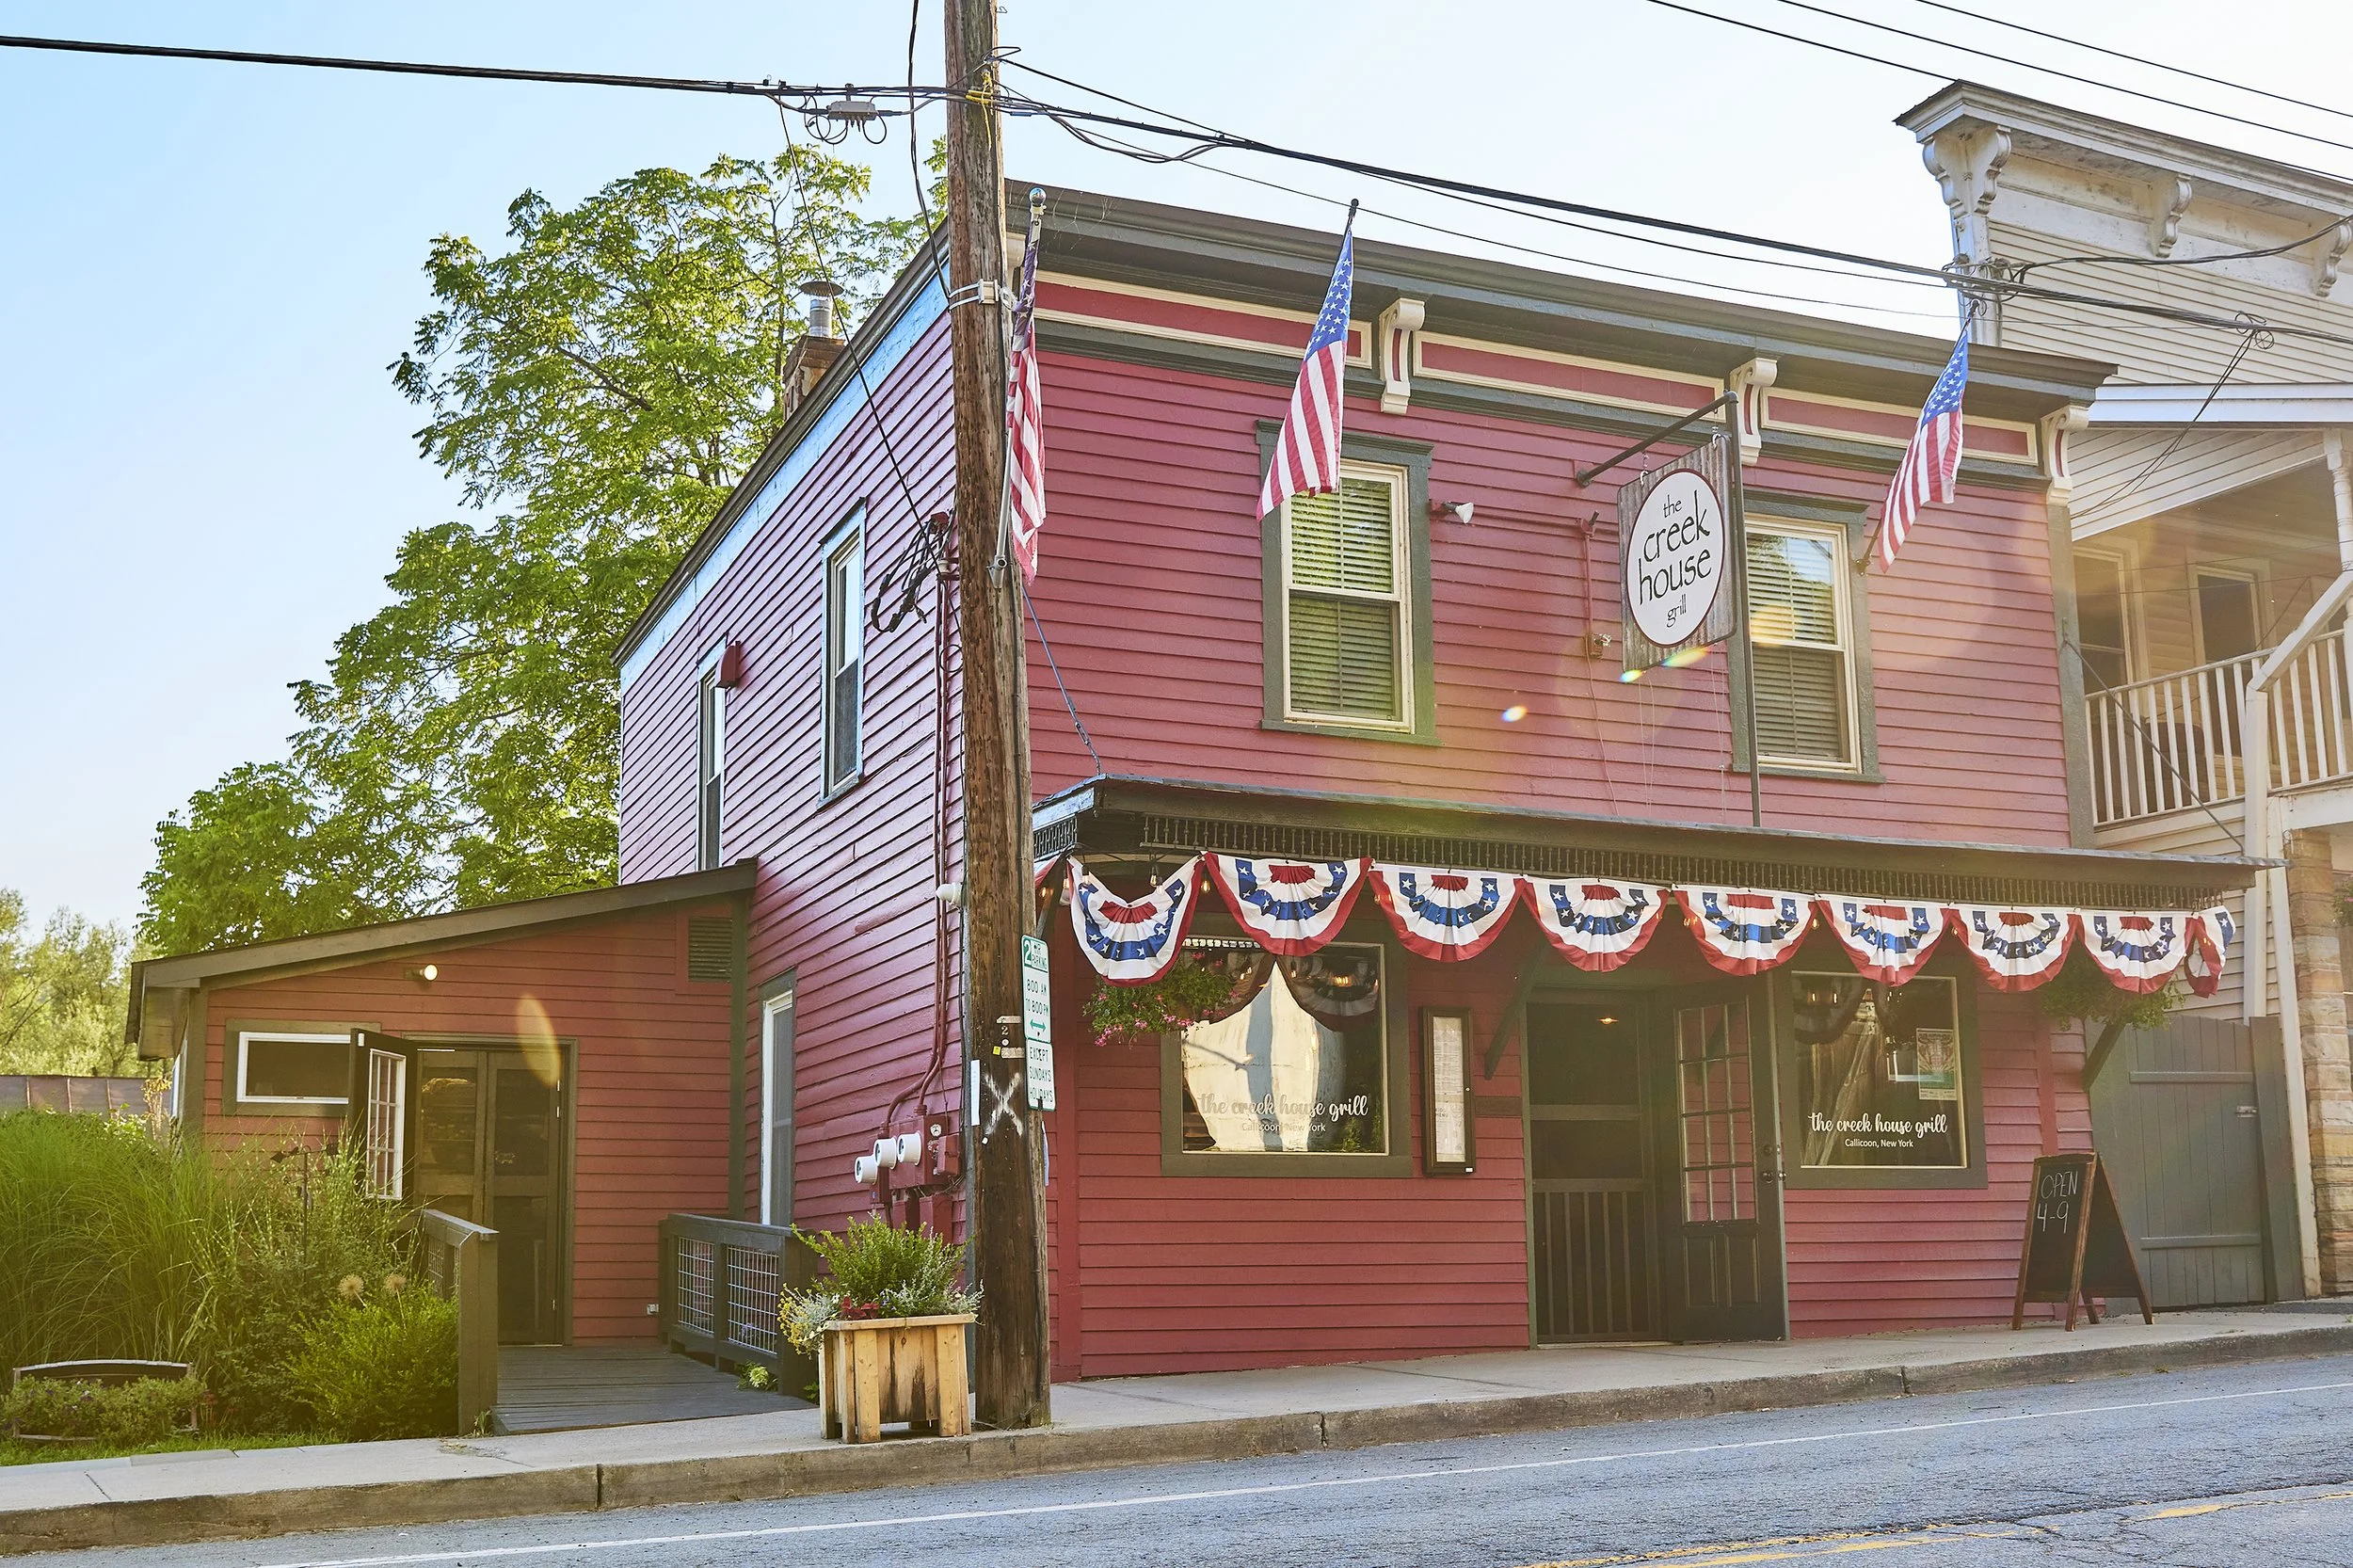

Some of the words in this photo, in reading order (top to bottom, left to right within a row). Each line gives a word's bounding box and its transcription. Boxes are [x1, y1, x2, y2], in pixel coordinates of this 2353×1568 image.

[1663, 494, 1683, 519] the
[1643, 490, 1711, 563] creek
[1638, 549, 1712, 605] house
[1666, 593, 1687, 628] grill
[1024, 939, 1032, 965] 2
[1041, 983, 1048, 996] AM
[1043, 1003, 1049, 1016] PM
[1029, 1046, 1049, 1062] EXCEPT
[1029, 1065, 1052, 1082] SUNDAYS
[1030, 1086, 1053, 1103] HOLIDAYS
[1197, 1093, 1227, 1114] the
[1230, 1094, 1276, 1115] creek
[1278, 1094, 1326, 1118] house
[1328, 1095, 1369, 1122] grill
[1286, 1123, 1305, 1131] New
[1307, 1122, 1326, 1132] York
[1807, 1112, 1833, 1132] the
[1836, 1112, 1873, 1132] creek
[1875, 1112, 1913, 1134] house
[1914, 1113, 1948, 1139] grill
[1845, 1138, 1880, 1148] Callicoon,
[1881, 1139, 1897, 1147] New
[1897, 1139, 1914, 1148] York
[2041, 1170, 2078, 1199] OPEN
[2037, 1200, 2069, 1234] 4-9
